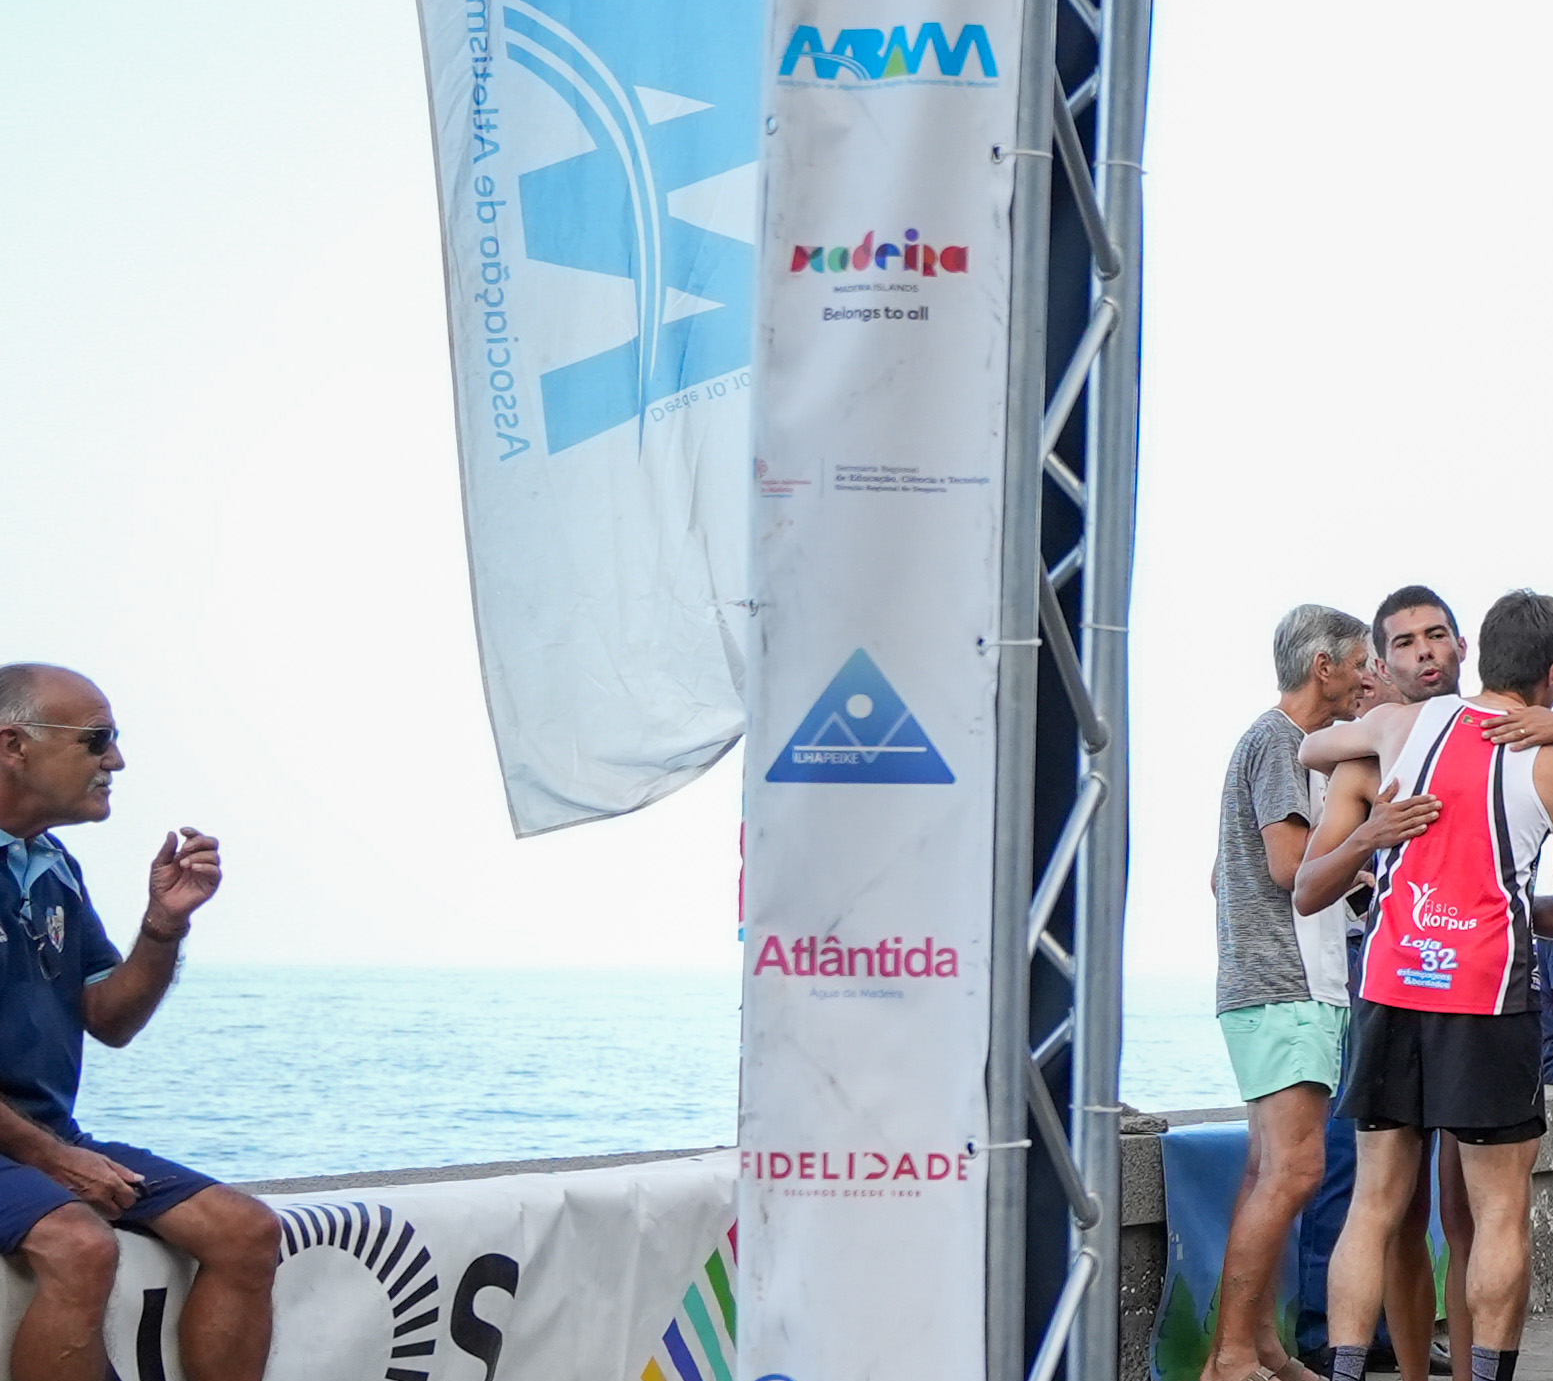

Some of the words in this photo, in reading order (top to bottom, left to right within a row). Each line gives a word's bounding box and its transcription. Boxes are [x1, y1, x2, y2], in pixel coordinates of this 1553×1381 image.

[823, 306, 881, 322] Belongs
[885, 307, 903, 320] to
[907, 306, 929, 320] all
[1422, 913, 1477, 930] Korpus
[1400, 934, 1442, 950] Loja
[753, 935, 959, 978] Atlântida
[1420, 948, 1458, 971] 32
[741, 1152, 968, 1180] FIDELIDADE
